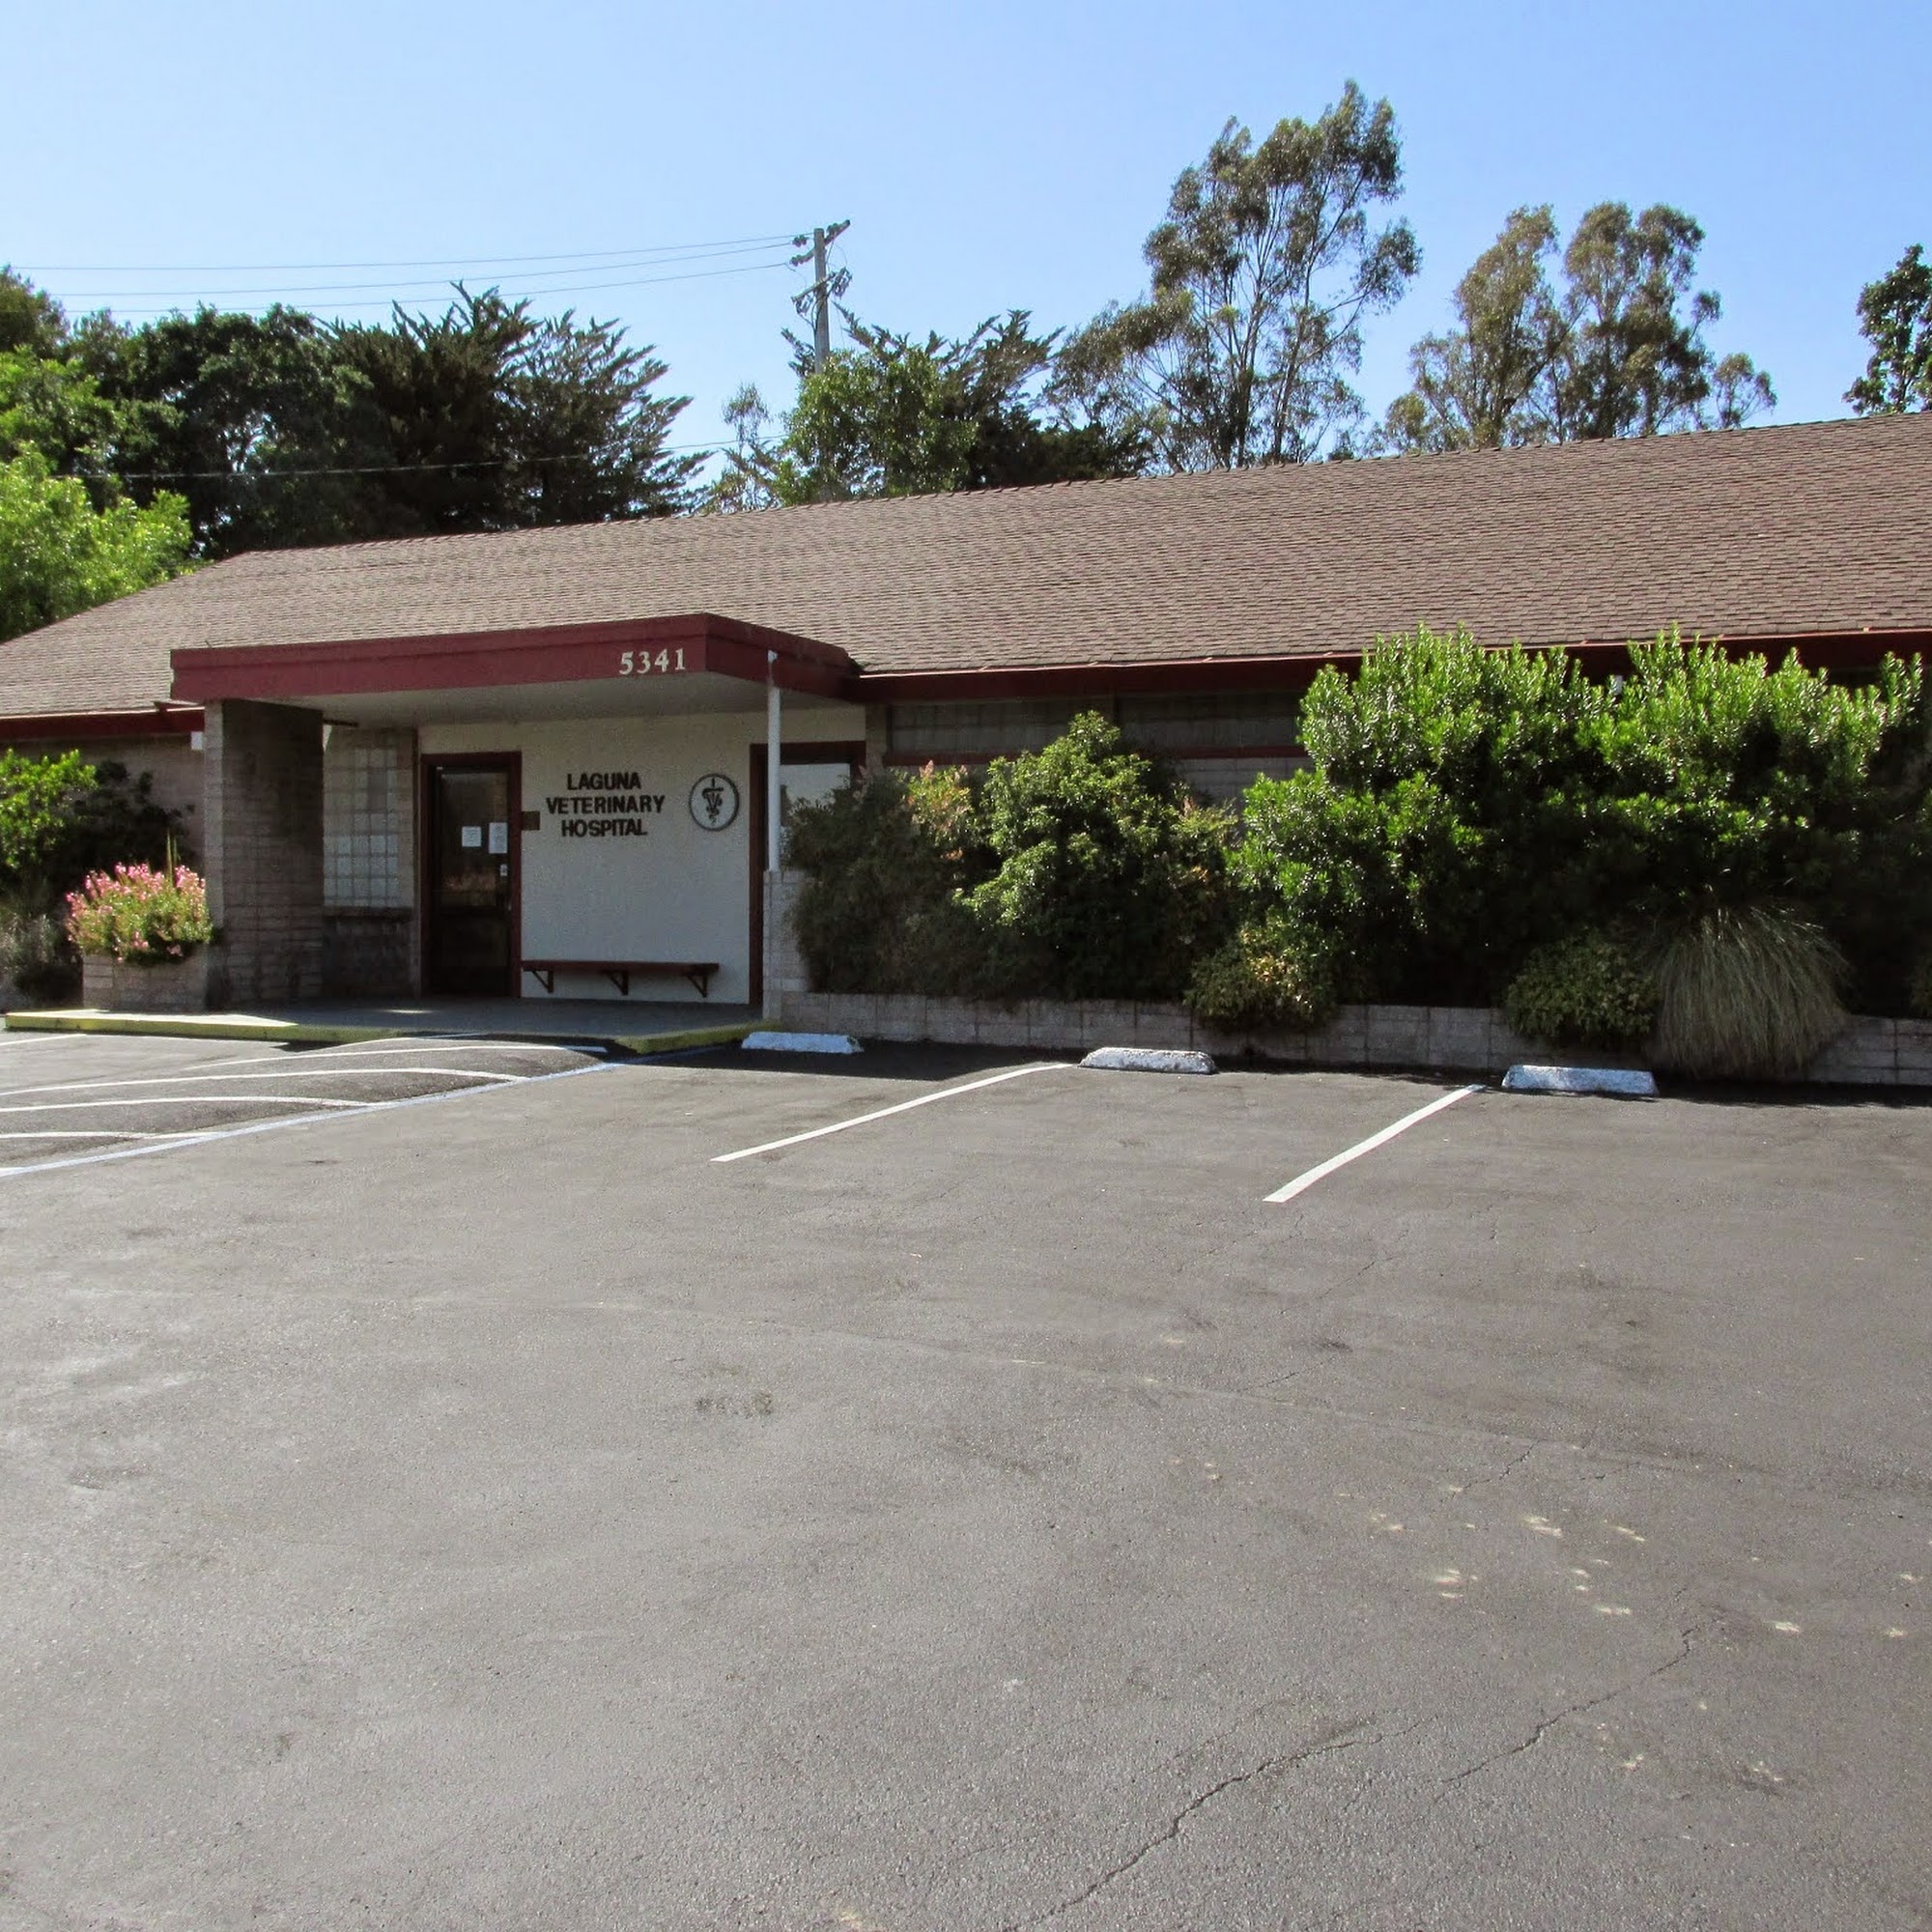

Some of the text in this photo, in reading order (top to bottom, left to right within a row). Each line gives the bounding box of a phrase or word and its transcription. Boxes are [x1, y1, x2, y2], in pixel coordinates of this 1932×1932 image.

[619, 648, 685, 674] 5341
[567, 772, 641, 790] LAGUNA
[546, 795, 665, 814] VETERINARY
[561, 818, 648, 838] HOSPITAL
